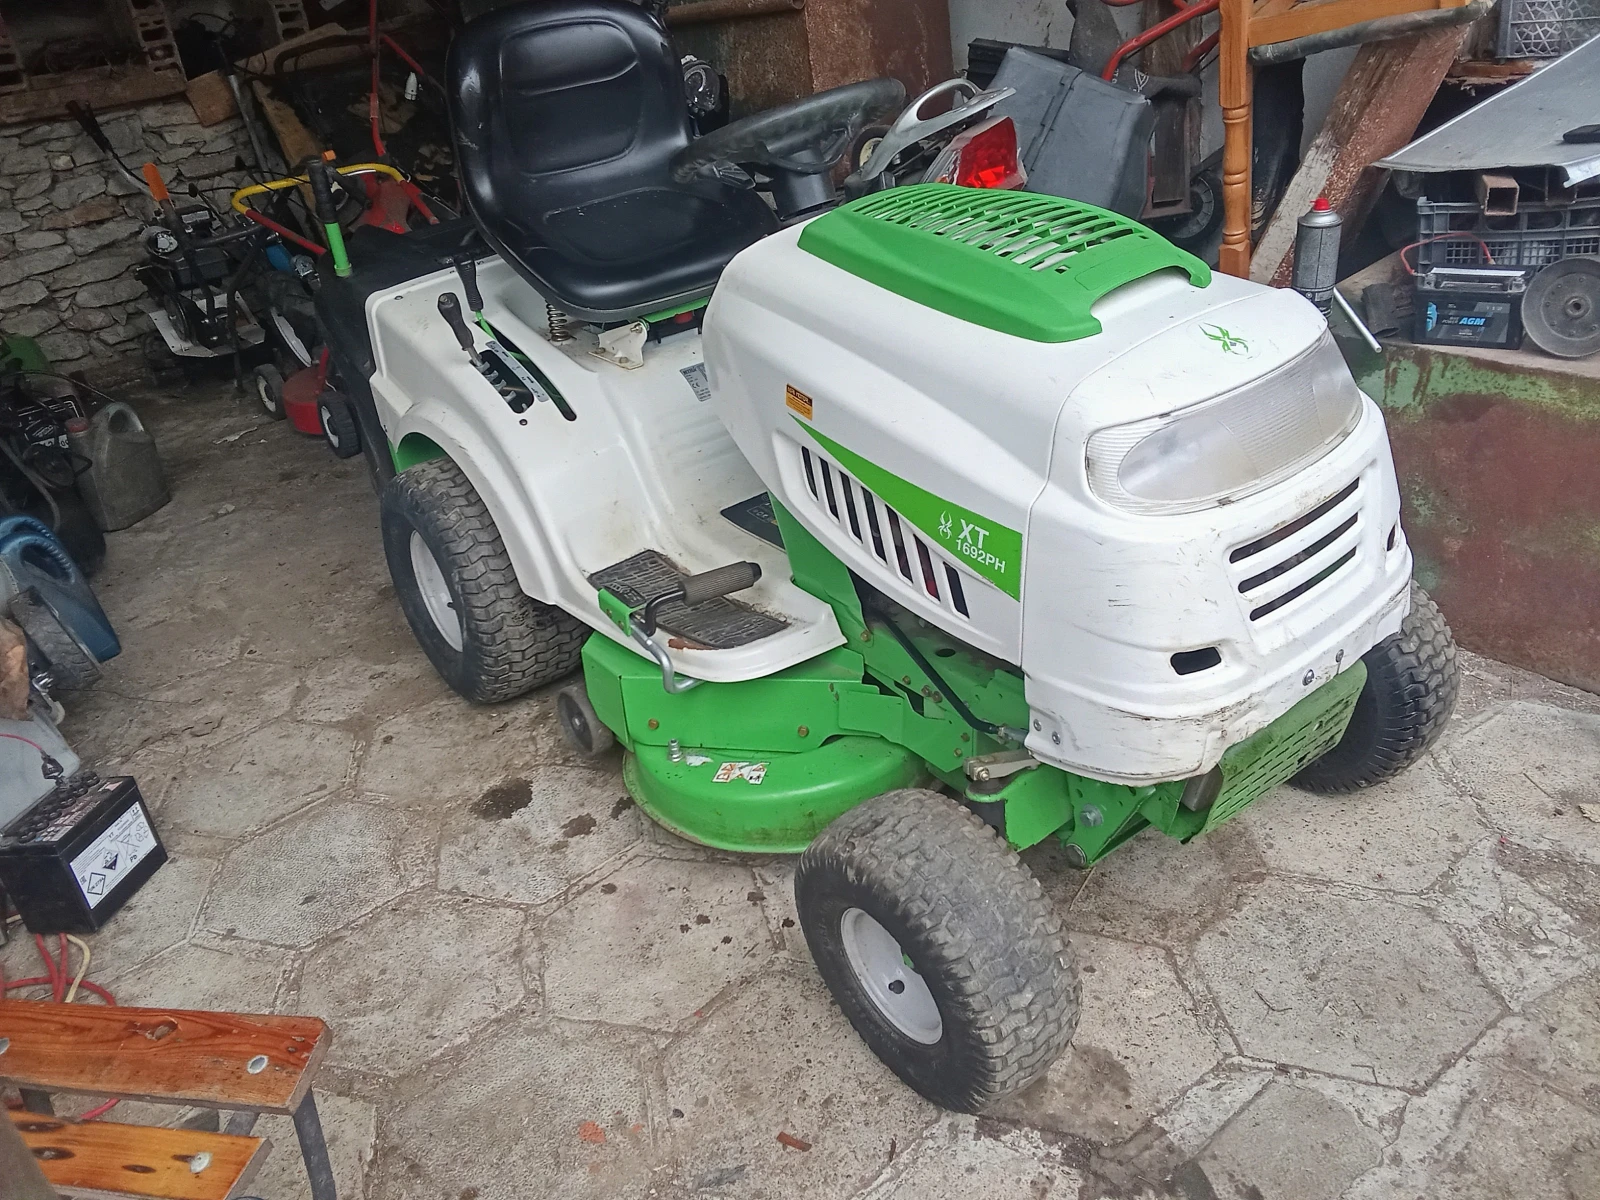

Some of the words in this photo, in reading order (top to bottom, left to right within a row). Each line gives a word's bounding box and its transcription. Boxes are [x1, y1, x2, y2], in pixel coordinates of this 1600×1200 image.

[1458, 316, 1486, 326] AGM
[958, 518, 990, 549] XT
[956, 539, 1006, 574] 1692PH
